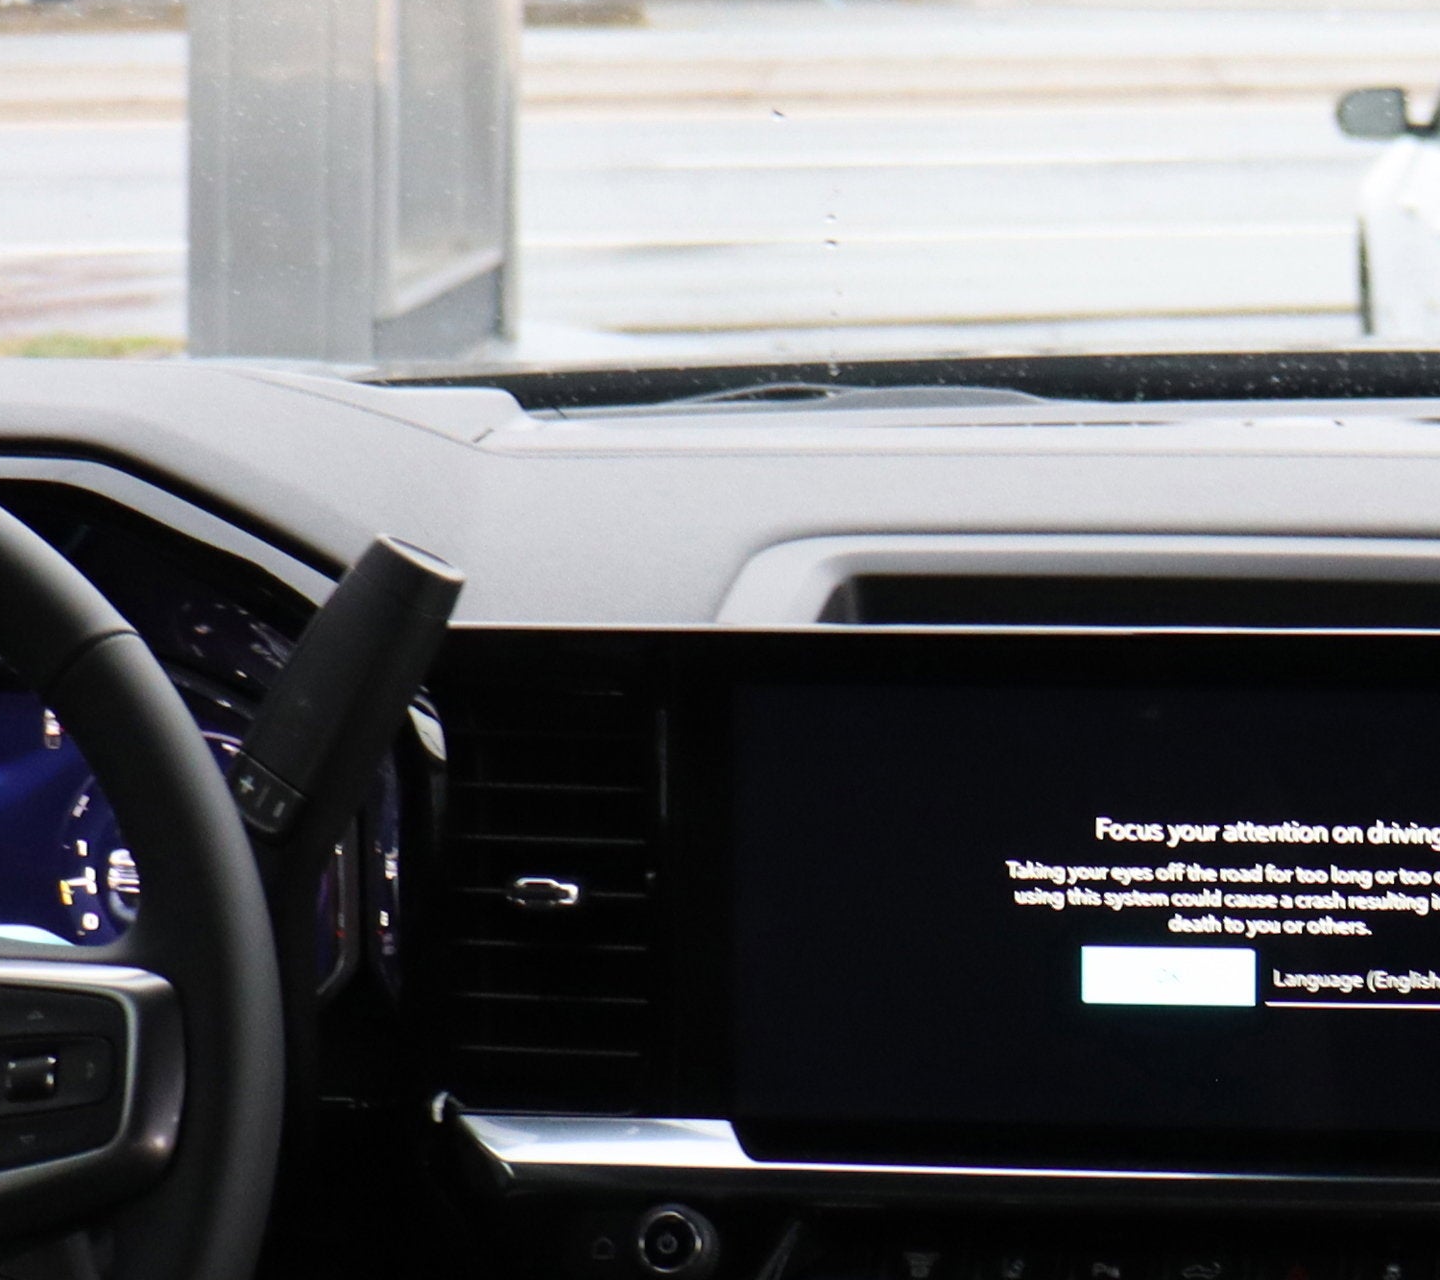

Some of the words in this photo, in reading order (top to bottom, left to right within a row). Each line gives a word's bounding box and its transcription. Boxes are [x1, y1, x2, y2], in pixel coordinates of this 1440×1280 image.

[1095, 817, 1165, 842] Focus
[1166, 824, 1220, 849] your
[1222, 821, 1329, 844] attention
[1331, 826, 1363, 845] on
[1005, 860, 1066, 885] Taking
[1067, 867, 1110, 885] your
[1110, 867, 1155, 886] eyes
[1154, 862, 1186, 882] off
[1186, 862, 1218, 883] the
[1220, 863, 1264, 883] road
[1265, 863, 1294, 884] for
[1295, 866, 1329, 885] too
[1330, 864, 1374, 890] long
[1375, 869, 1398, 885] or
[1399, 867, 1432, 885] too
[1014, 887, 1066, 911] using
[1067, 886, 1103, 906] this
[1103, 889, 1170, 911] system
[1171, 888, 1223, 908] could
[1223, 893, 1278, 909] cause
[1279, 894, 1294, 909] a
[1294, 890, 1347, 910] crash
[1348, 890, 1430, 916] resulting
[1168, 913, 1222, 933] death
[1223, 915, 1245, 934] to
[1245, 919, 1282, 939] you
[1282, 920, 1306, 935] or
[1306, 915, 1373, 936] others.
[1272, 968, 1364, 994] Language
